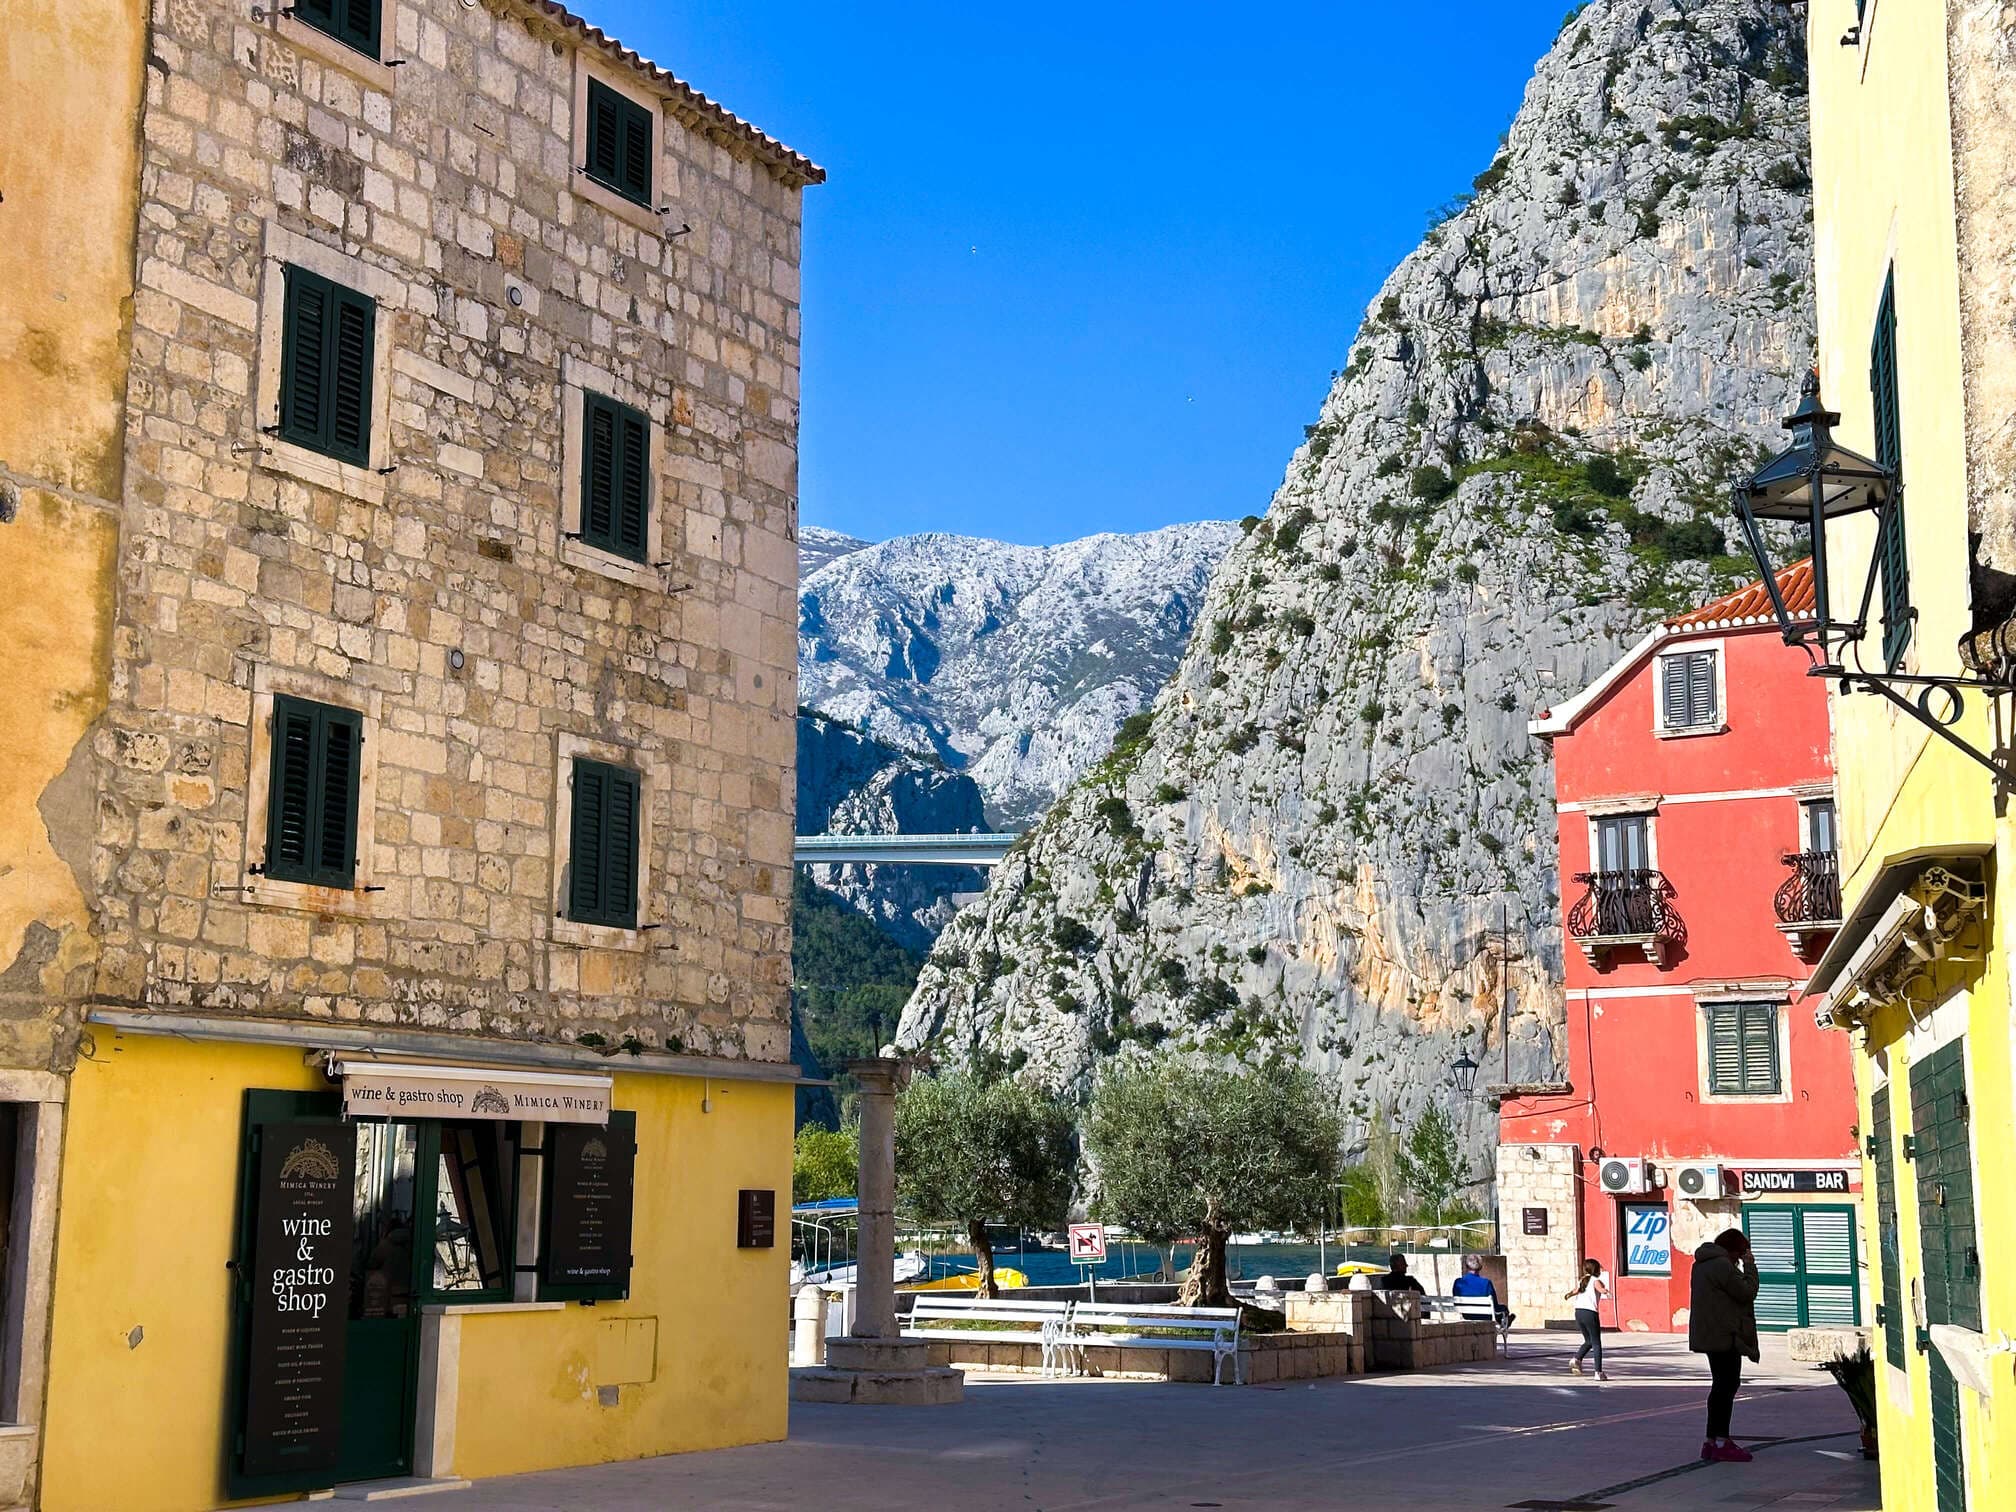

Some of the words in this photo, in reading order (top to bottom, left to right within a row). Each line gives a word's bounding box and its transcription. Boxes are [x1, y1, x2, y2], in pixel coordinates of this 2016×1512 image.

[352, 1086, 382, 1100] wine
[385, 1086, 396, 1101] &
[399, 1089, 434, 1106] gastro
[437, 1089, 464, 1108] shop
[1815, 1172, 1844, 1189] BAR
[282, 1212, 331, 1236] wine
[1629, 1211, 1667, 1241] Zip
[296, 1236, 314, 1261] &
[1629, 1245, 1669, 1265] Line
[272, 1264, 334, 1295] gastro
[278, 1286, 327, 1318] shop
